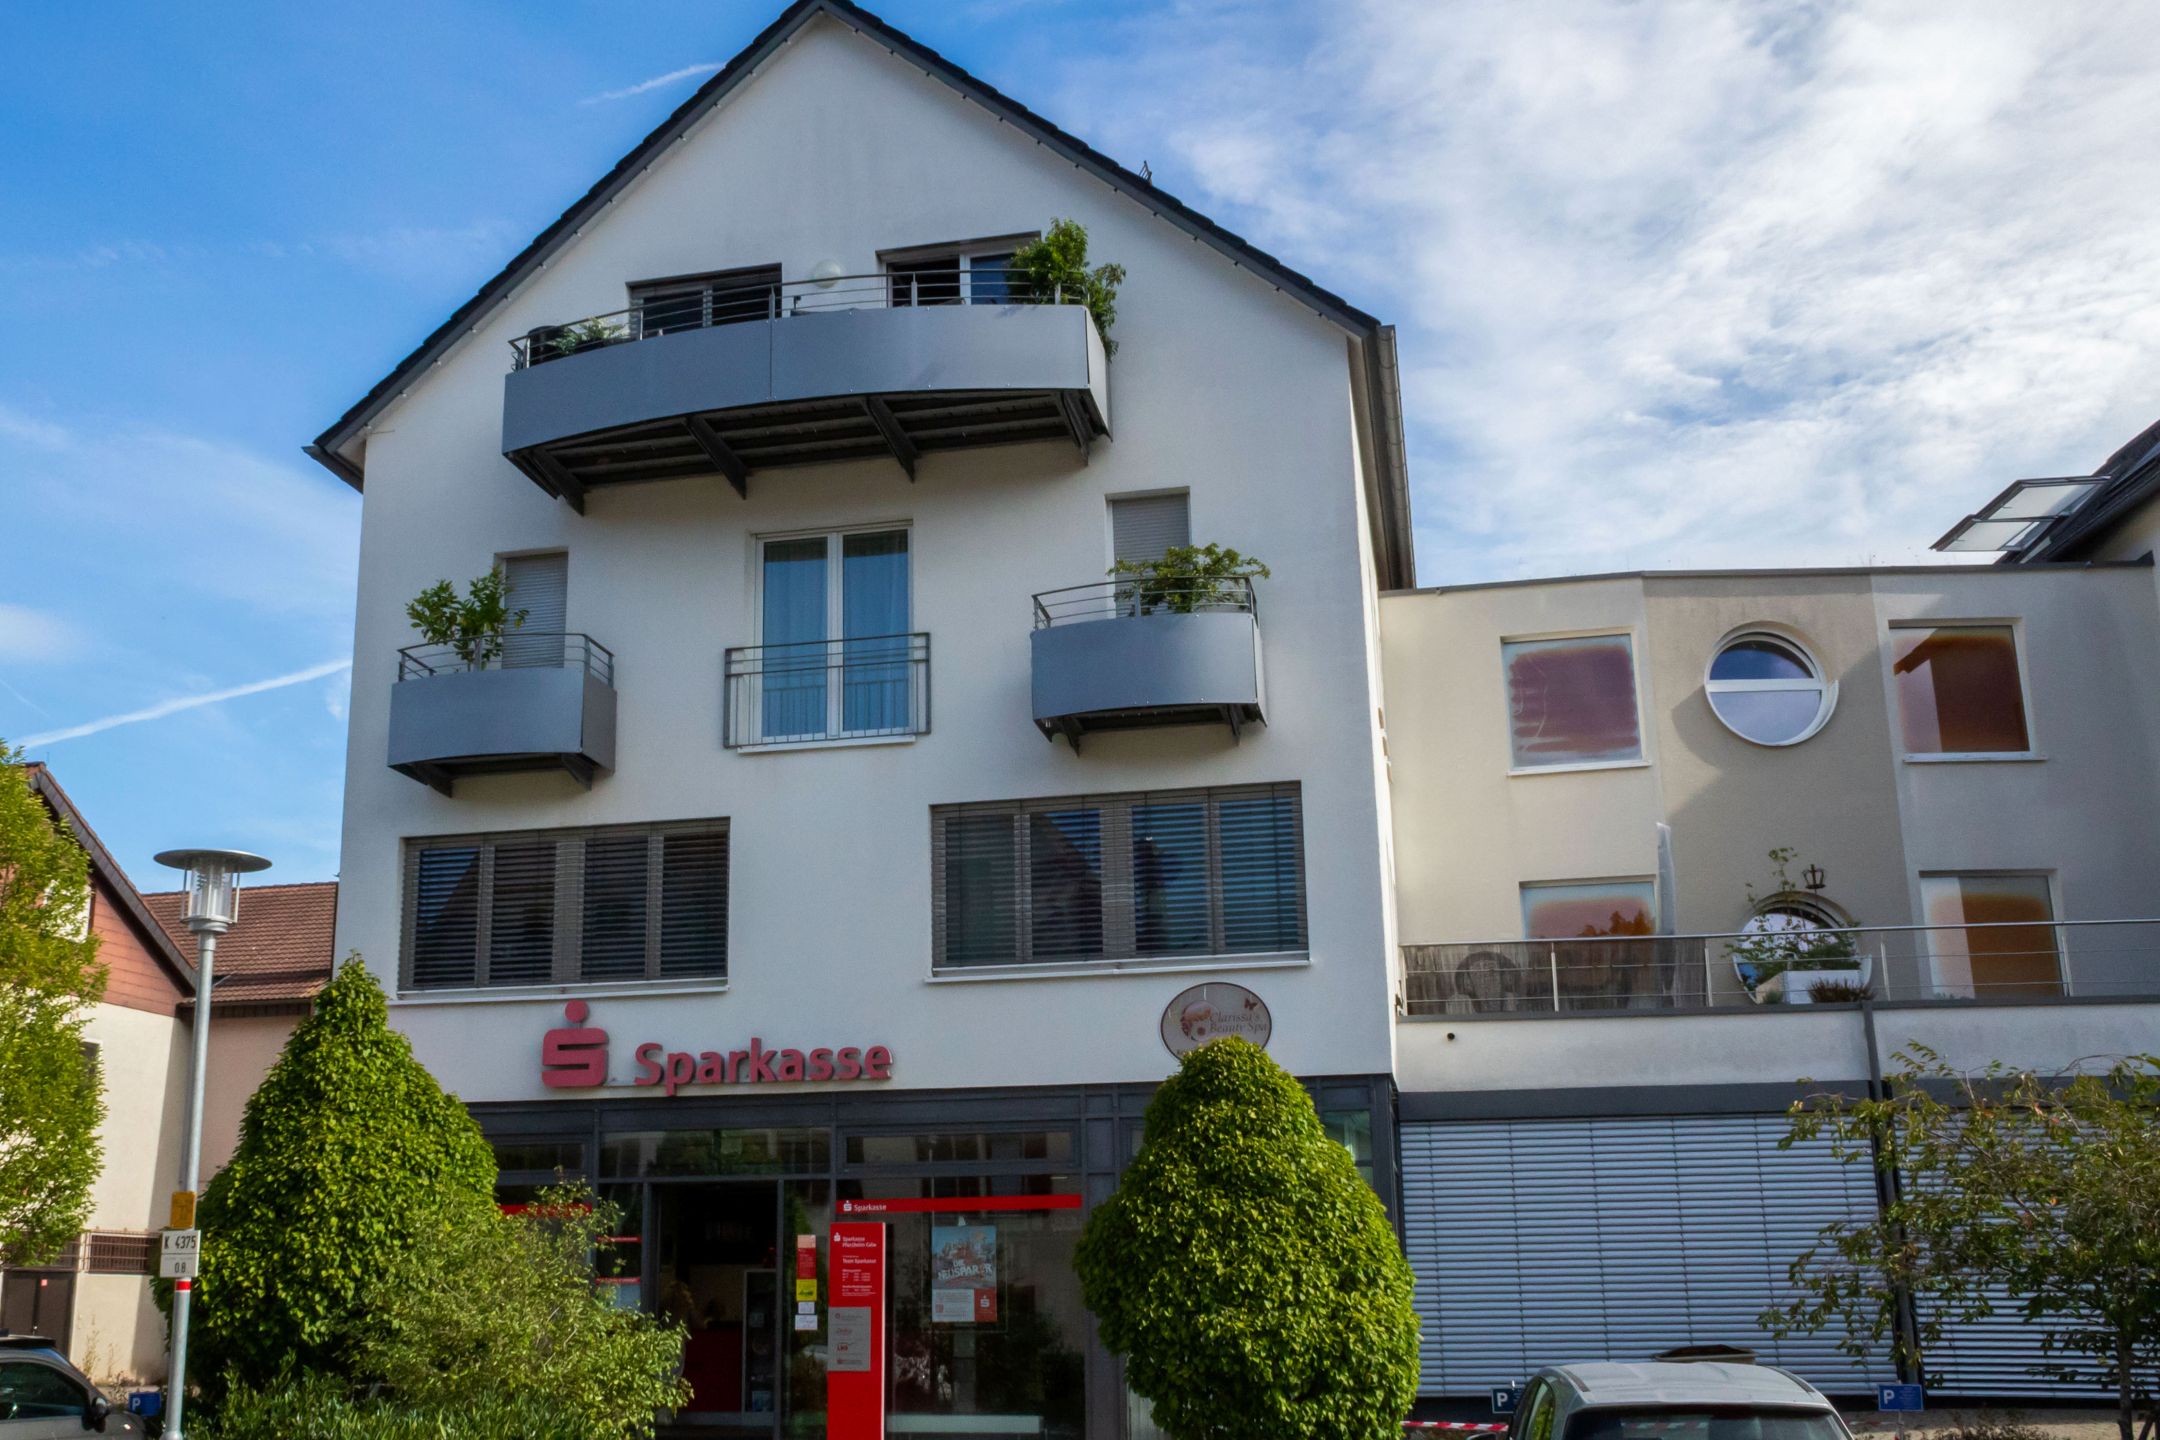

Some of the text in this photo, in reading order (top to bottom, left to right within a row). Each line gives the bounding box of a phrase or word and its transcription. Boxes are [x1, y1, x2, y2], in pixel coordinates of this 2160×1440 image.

[1209, 1011, 1260, 1023] Clarissa's
[1209, 1021, 1267, 1034] Beauty Spa
[635, 1036, 894, 1097] Sparkasse
[854, 1204, 887, 1212] Sparkasse
[164, 1235, 197, 1249] K 4375
[937, 1262, 993, 1281] NEUSPARR
[132, 1397, 141, 1411] P
[1496, 1392, 1508, 1407] P
[1883, 1389, 1895, 1405] P
